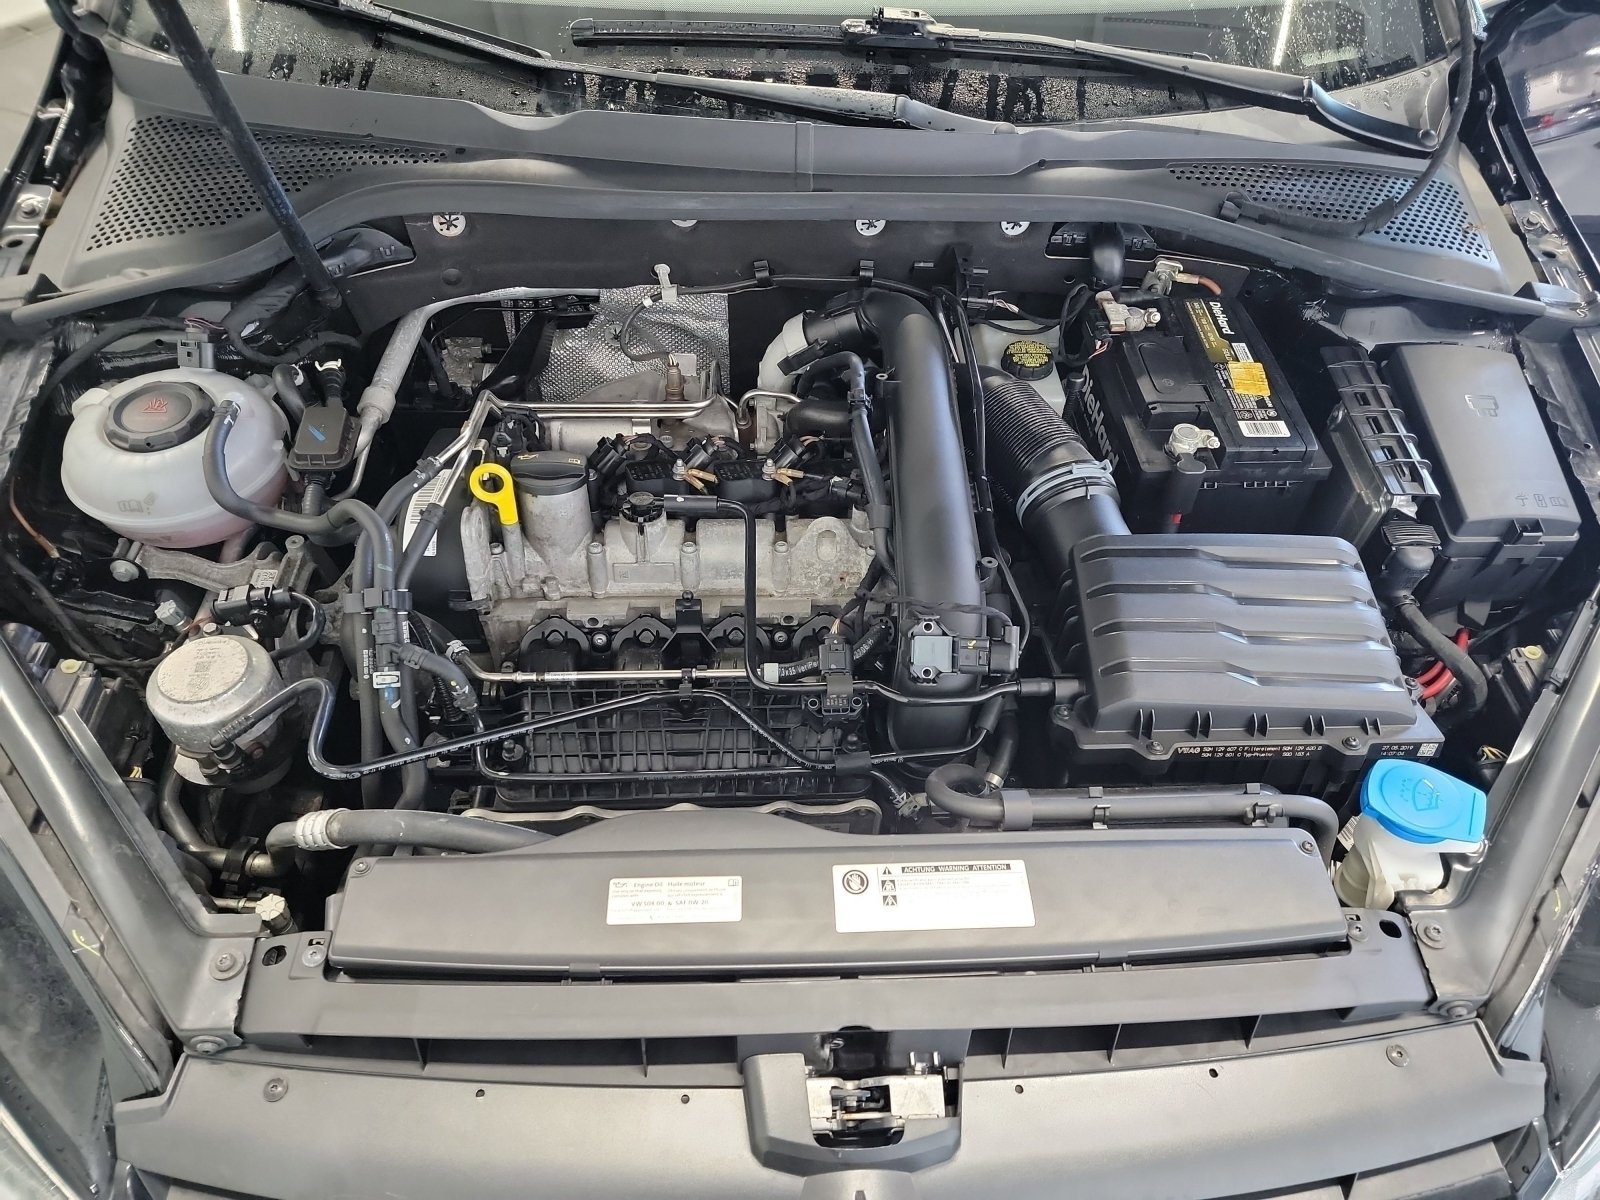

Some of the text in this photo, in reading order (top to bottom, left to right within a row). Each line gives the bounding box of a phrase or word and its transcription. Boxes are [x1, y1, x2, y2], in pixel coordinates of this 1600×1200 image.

[1209, 301, 1235, 335] DieHard
[904, 863, 1007, 873] ACHTUNG WARNING ATTENTION
